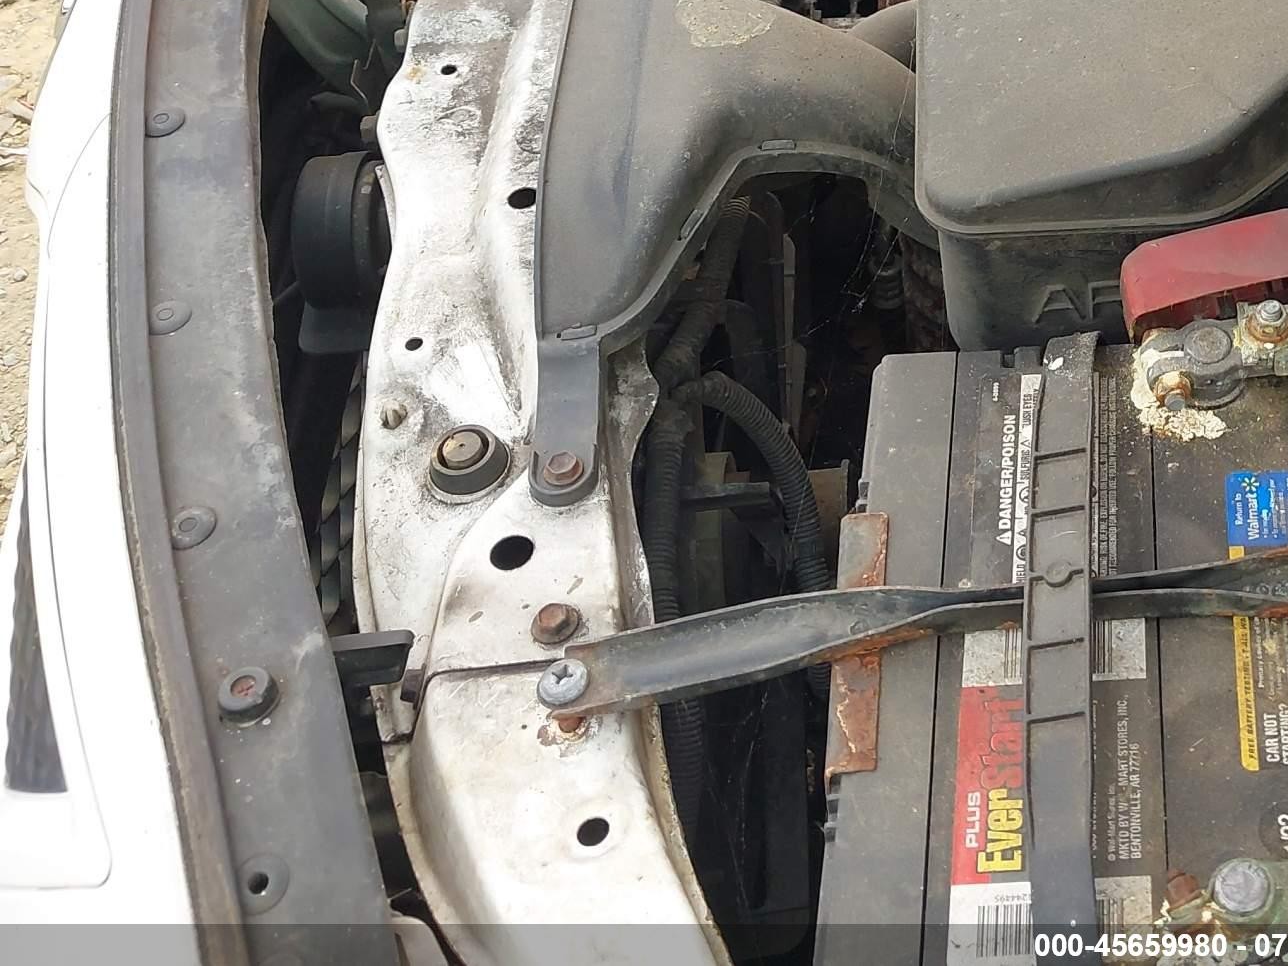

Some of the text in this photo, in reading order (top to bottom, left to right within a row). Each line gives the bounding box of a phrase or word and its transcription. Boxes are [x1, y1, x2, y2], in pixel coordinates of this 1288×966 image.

[998, 414, 1017, 530] DANGER/POISON
[1234, 501, 1244, 526] Return
[1245, 492, 1260, 540] Walmart
[1116, 717, 1130, 757] STORES,
[1263, 713, 1279, 736] NOT
[1264, 738, 1281, 762] CAR
[976, 697, 1024, 875] EverStart
[1116, 758, 1130, 813] W-MART
[1129, 774, 1141, 788] AR
[964, 790, 982, 849] PLUS
[1117, 814, 1129, 828] BY
[1129, 788, 1143, 859] BENTONVILLE,
